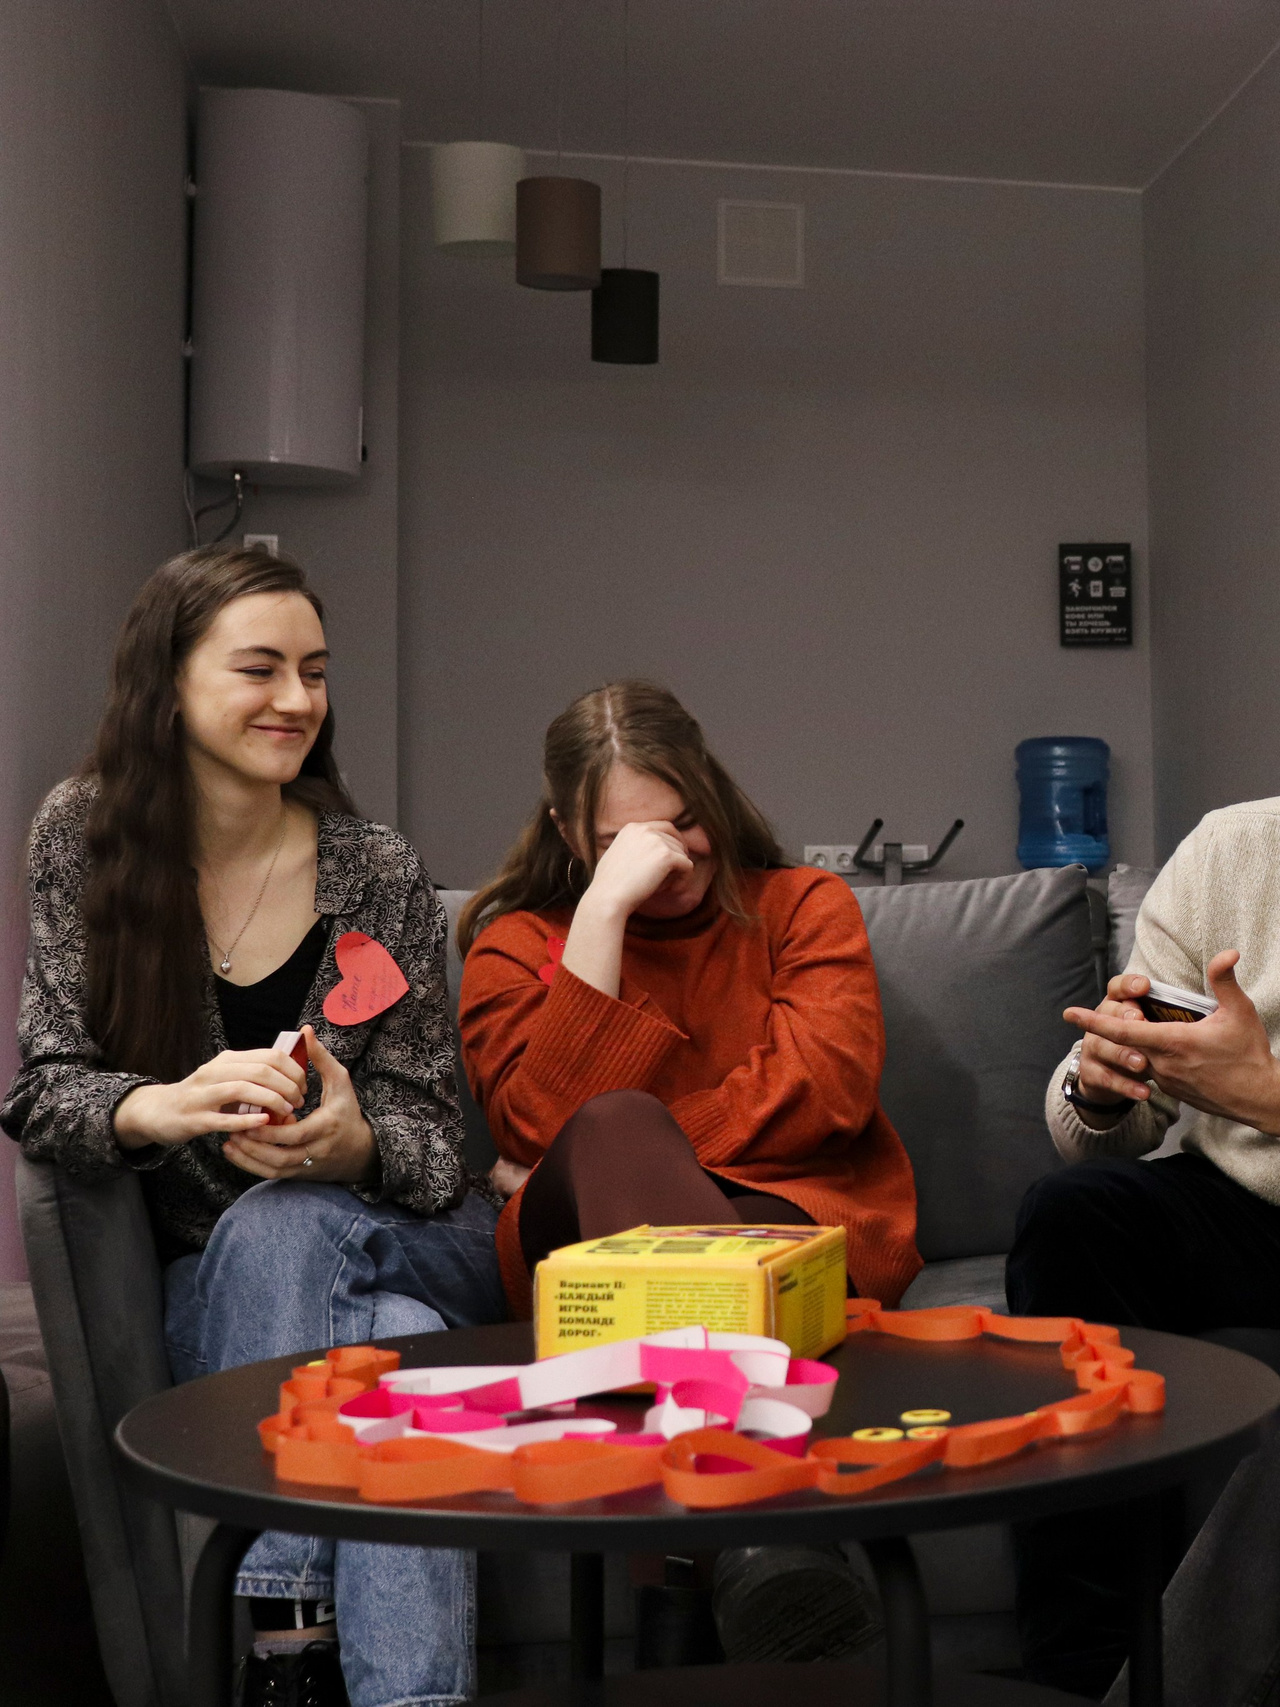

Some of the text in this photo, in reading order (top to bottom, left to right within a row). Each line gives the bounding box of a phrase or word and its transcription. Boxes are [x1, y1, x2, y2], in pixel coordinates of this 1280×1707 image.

[559, 1280, 610, 1289] Вариант
[558, 1304, 599, 1313] ИГРОК
[558, 1316, 616, 1326] КОМАНДЕ
